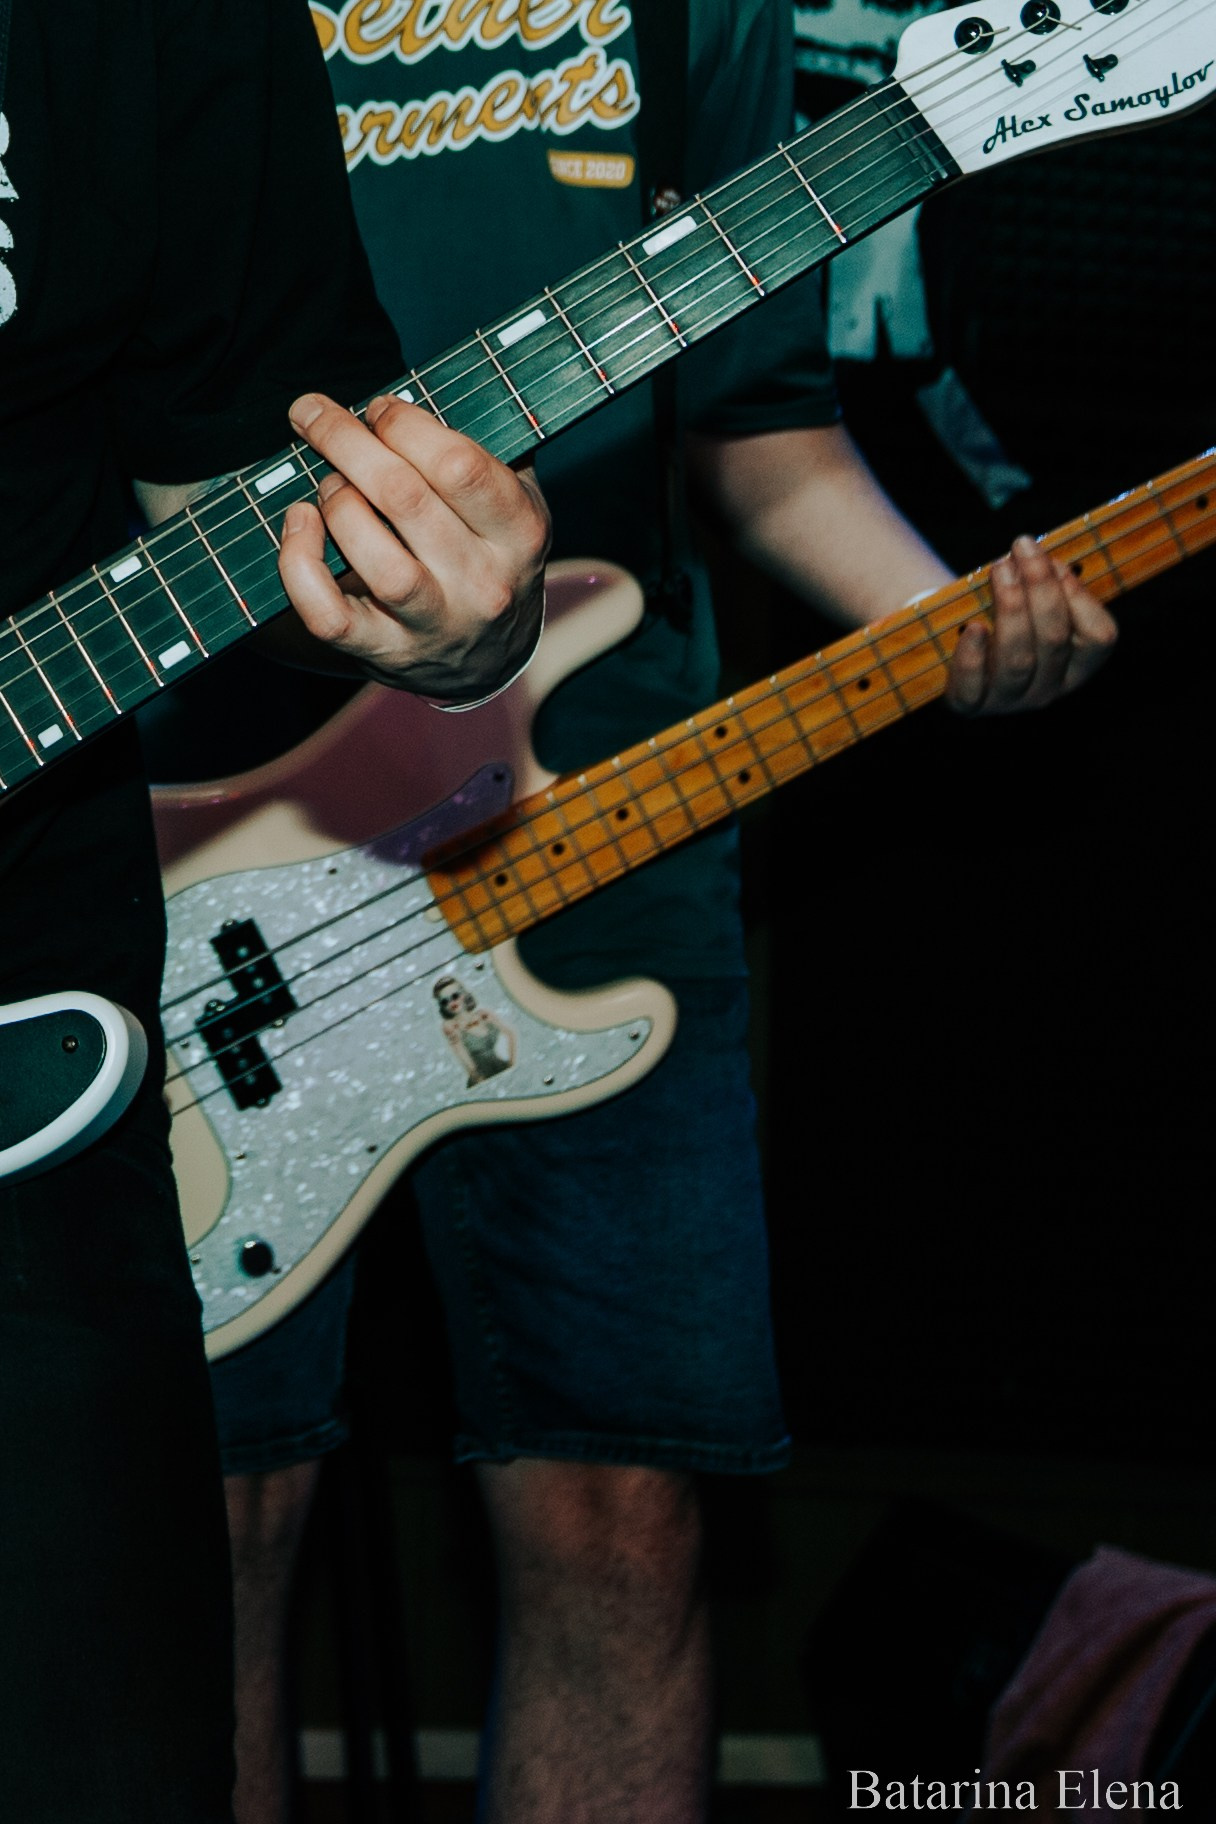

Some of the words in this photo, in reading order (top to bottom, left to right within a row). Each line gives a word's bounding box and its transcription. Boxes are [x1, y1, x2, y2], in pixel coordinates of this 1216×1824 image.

[335, 46, 641, 174] rments
[982, 114, 1053, 155] Alex
[1063, 59, 1215, 122] Samoylov
[585, 158, 627, 181] 2020
